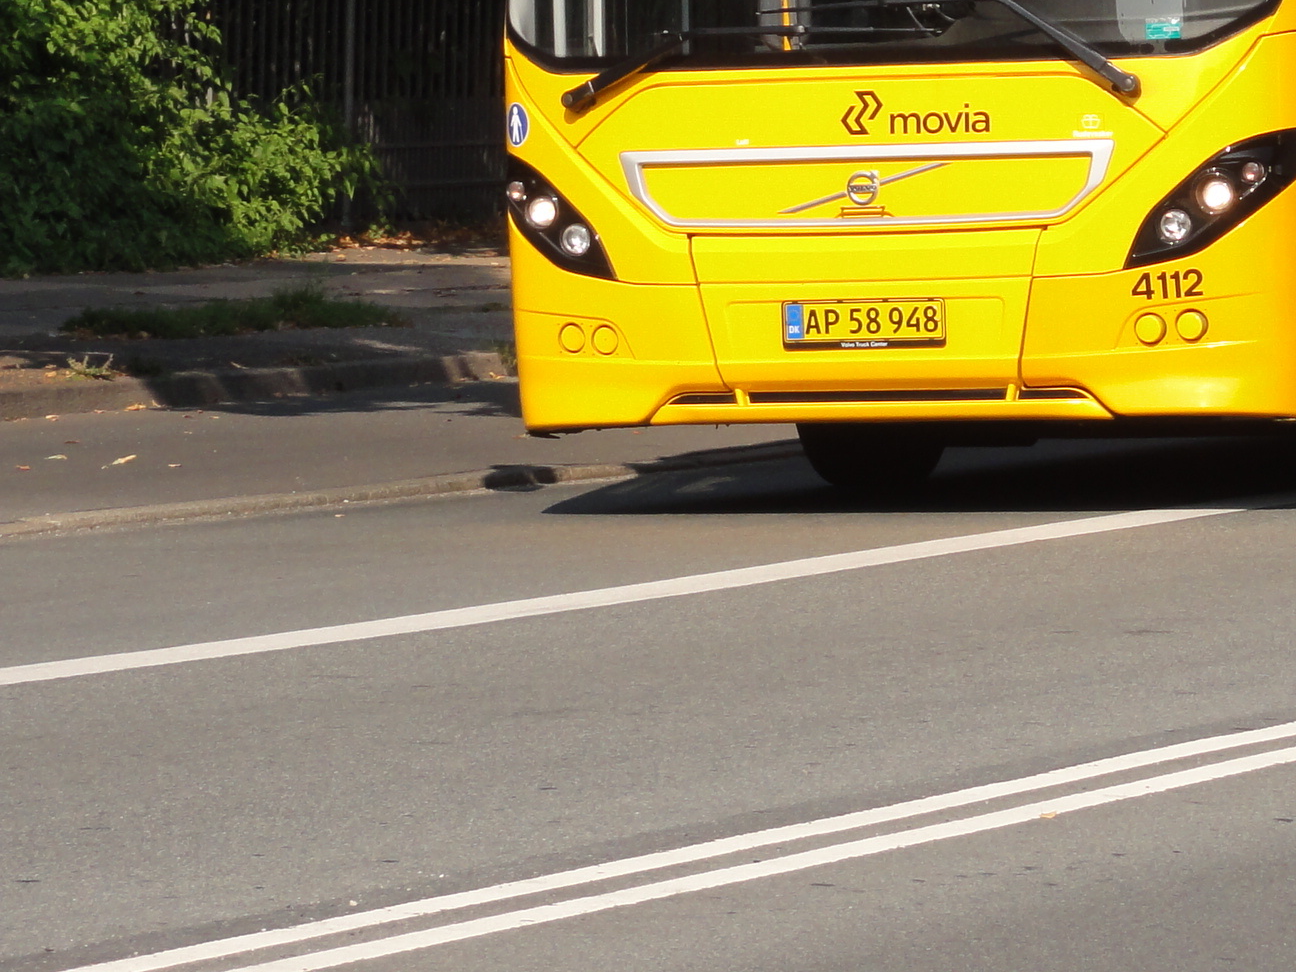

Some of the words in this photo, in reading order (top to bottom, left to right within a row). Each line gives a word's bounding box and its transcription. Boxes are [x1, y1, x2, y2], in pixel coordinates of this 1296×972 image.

[890, 103, 990, 134] movia
[1132, 268, 1204, 299] 4112
[789, 325, 800, 334] DK
[805, 309, 840, 334] AP
[849, 307, 882, 334] 58
[888, 306, 939, 334] 948
